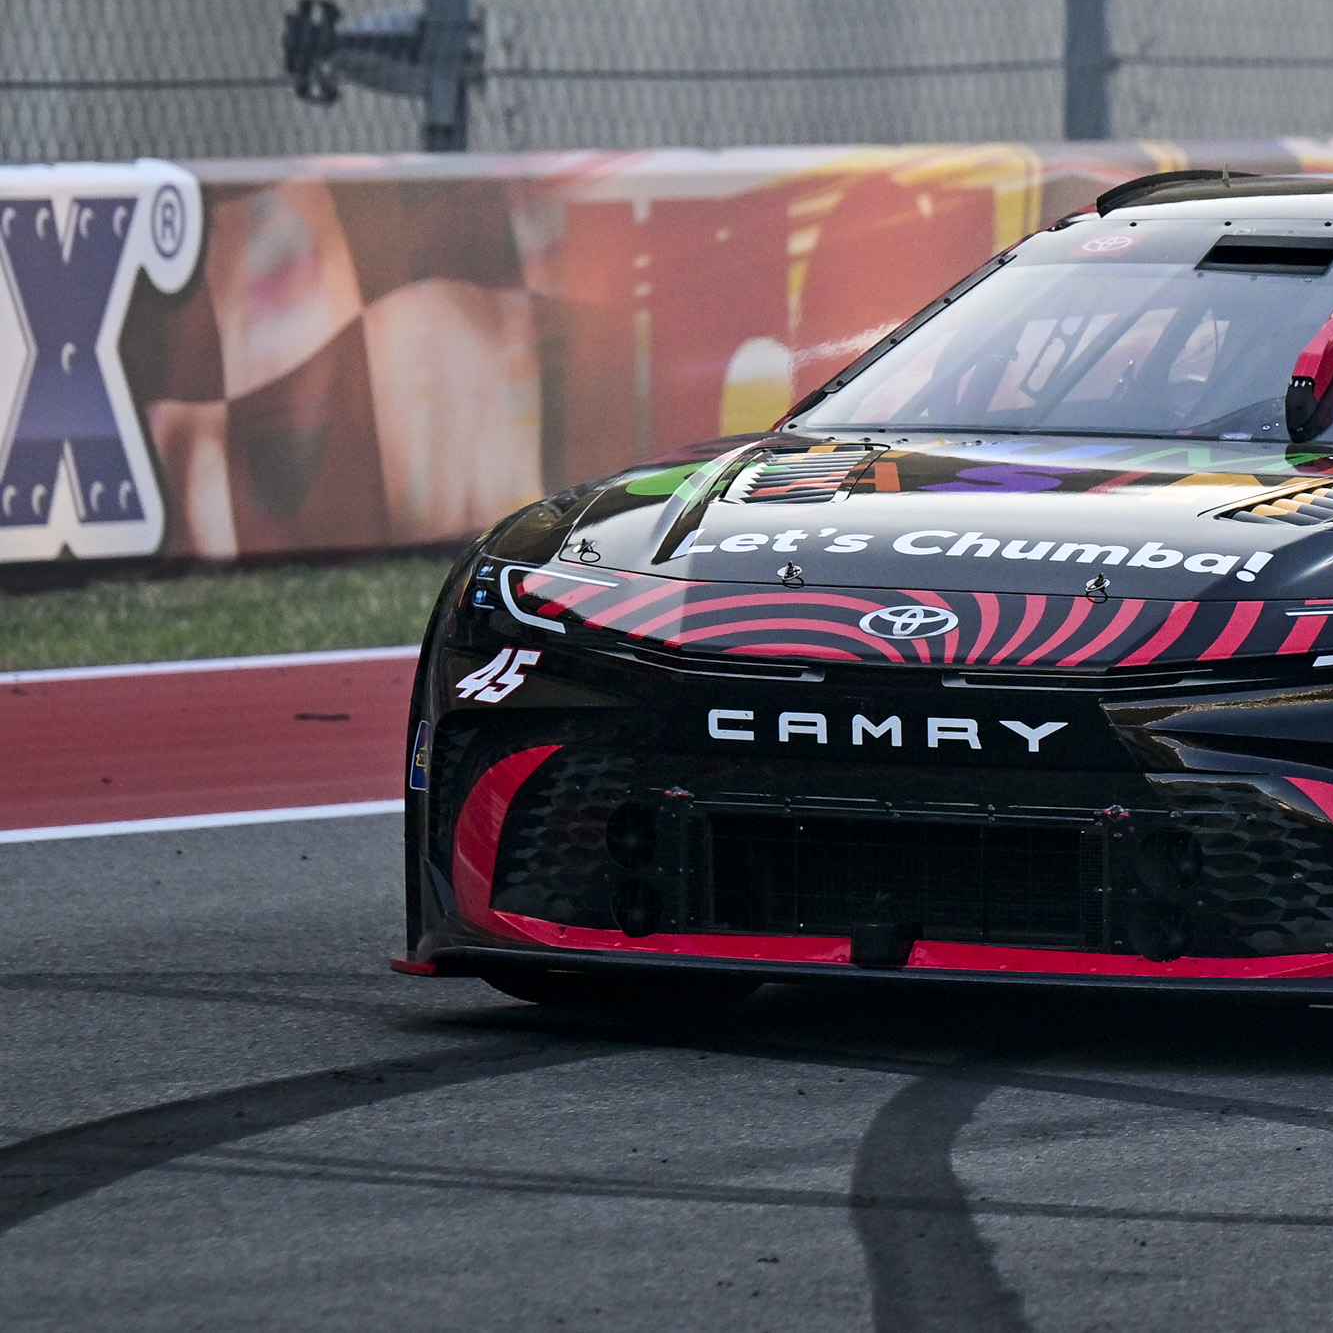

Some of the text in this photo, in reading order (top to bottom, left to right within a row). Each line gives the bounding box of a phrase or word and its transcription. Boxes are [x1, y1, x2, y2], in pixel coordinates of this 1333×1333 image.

[669, 528, 1274, 583] Let's Chumba!
[455, 648, 543, 703] 45
[708, 708, 1068, 752] CAMRY
